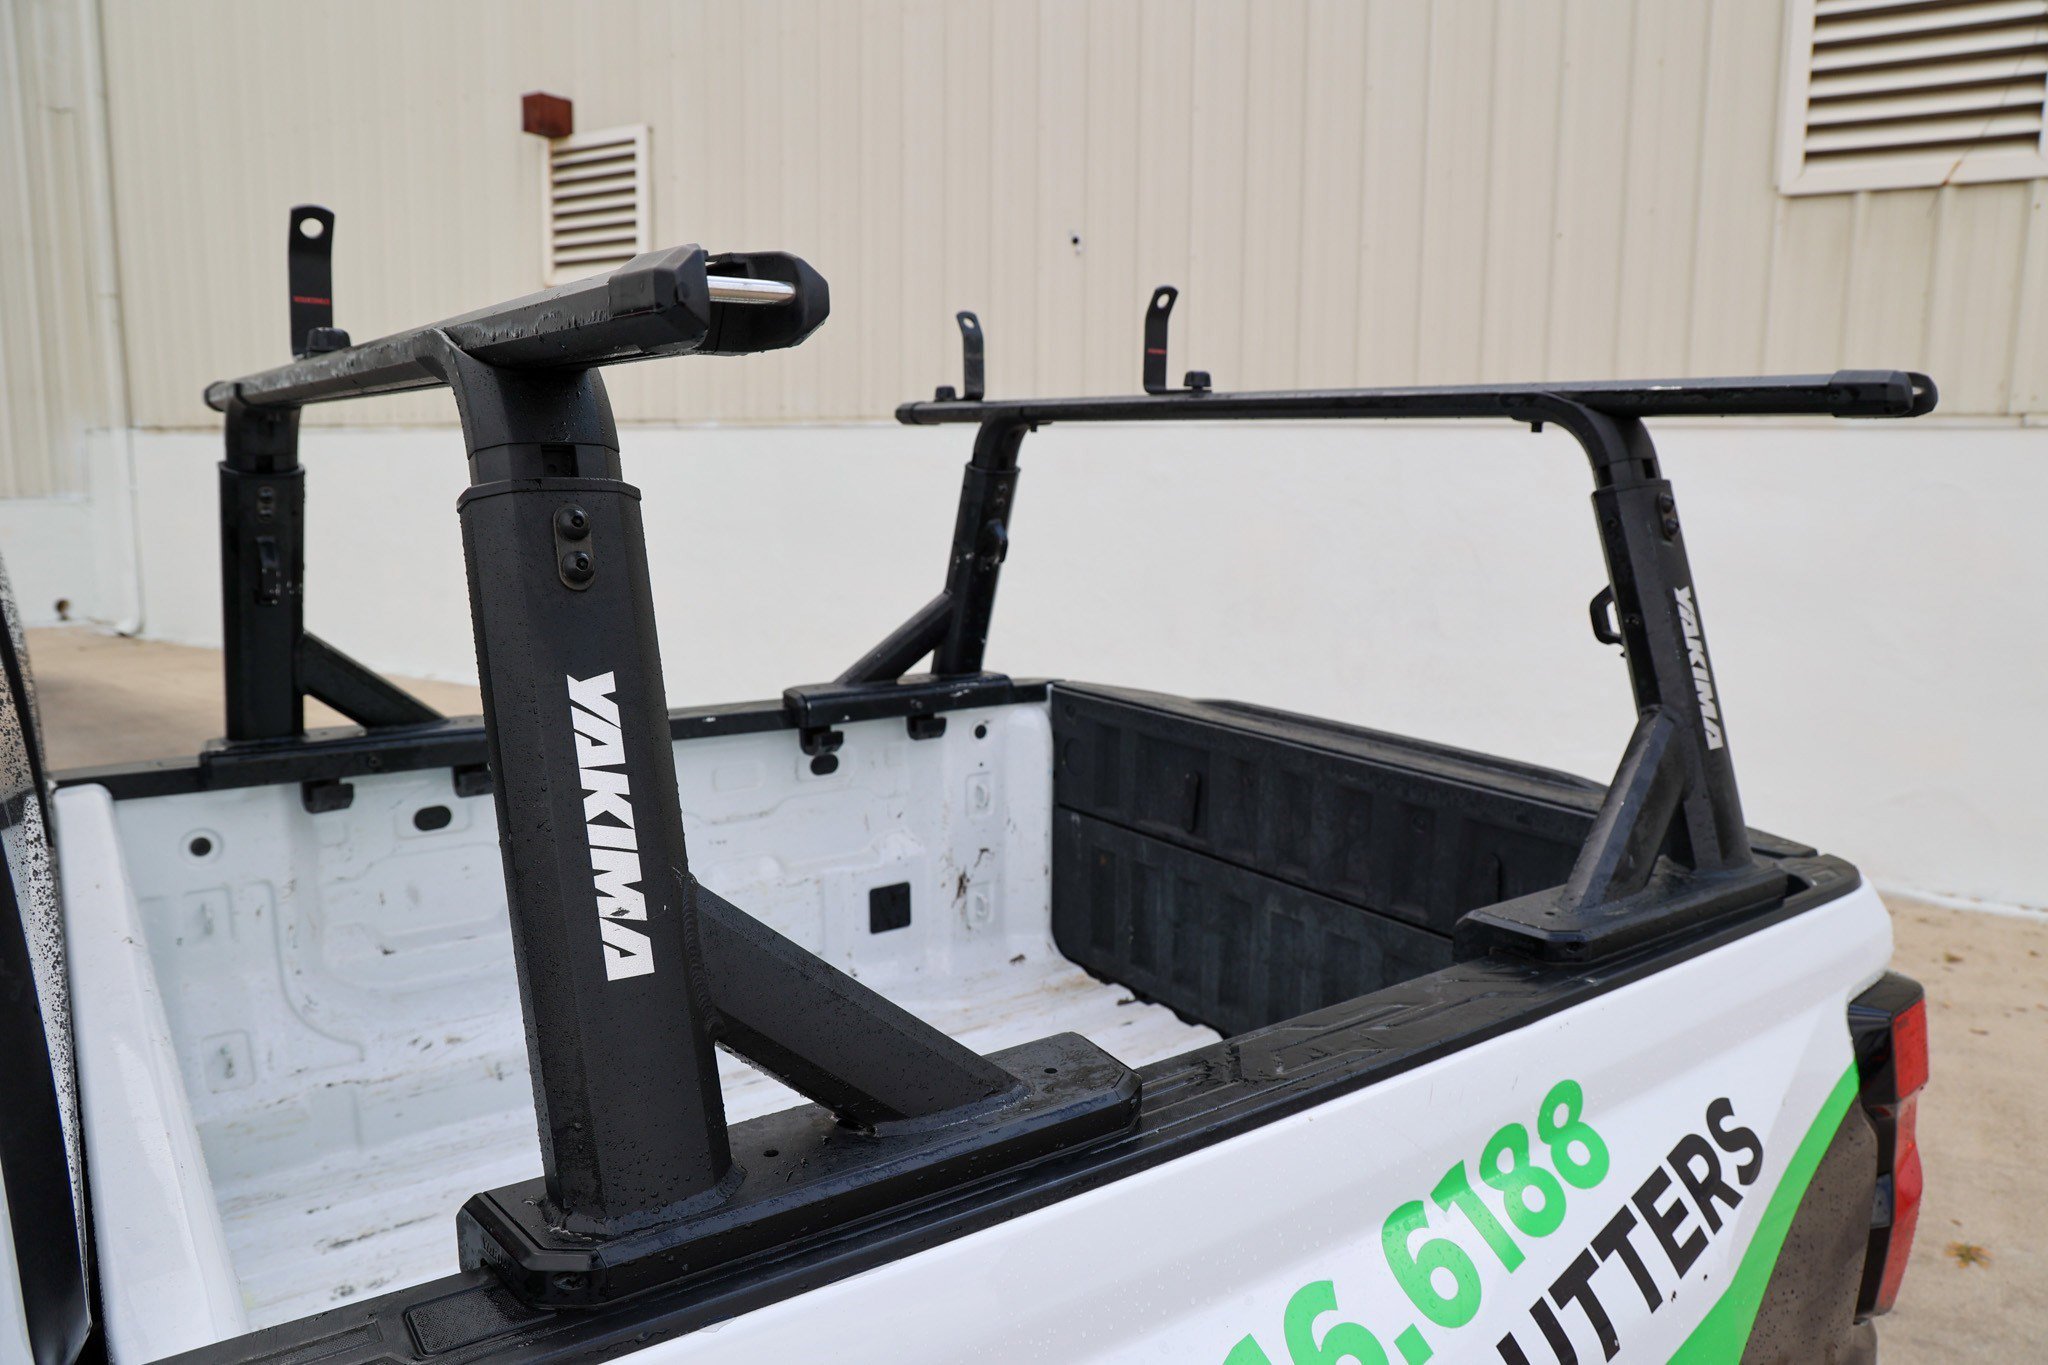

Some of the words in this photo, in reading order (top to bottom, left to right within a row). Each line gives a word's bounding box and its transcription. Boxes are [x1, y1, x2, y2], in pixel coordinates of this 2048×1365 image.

[1673, 585, 1723, 750] YAKIMA
[566, 671, 655, 981] YAKIMA
[1221, 1079, 1610, 1365] 6.6188
